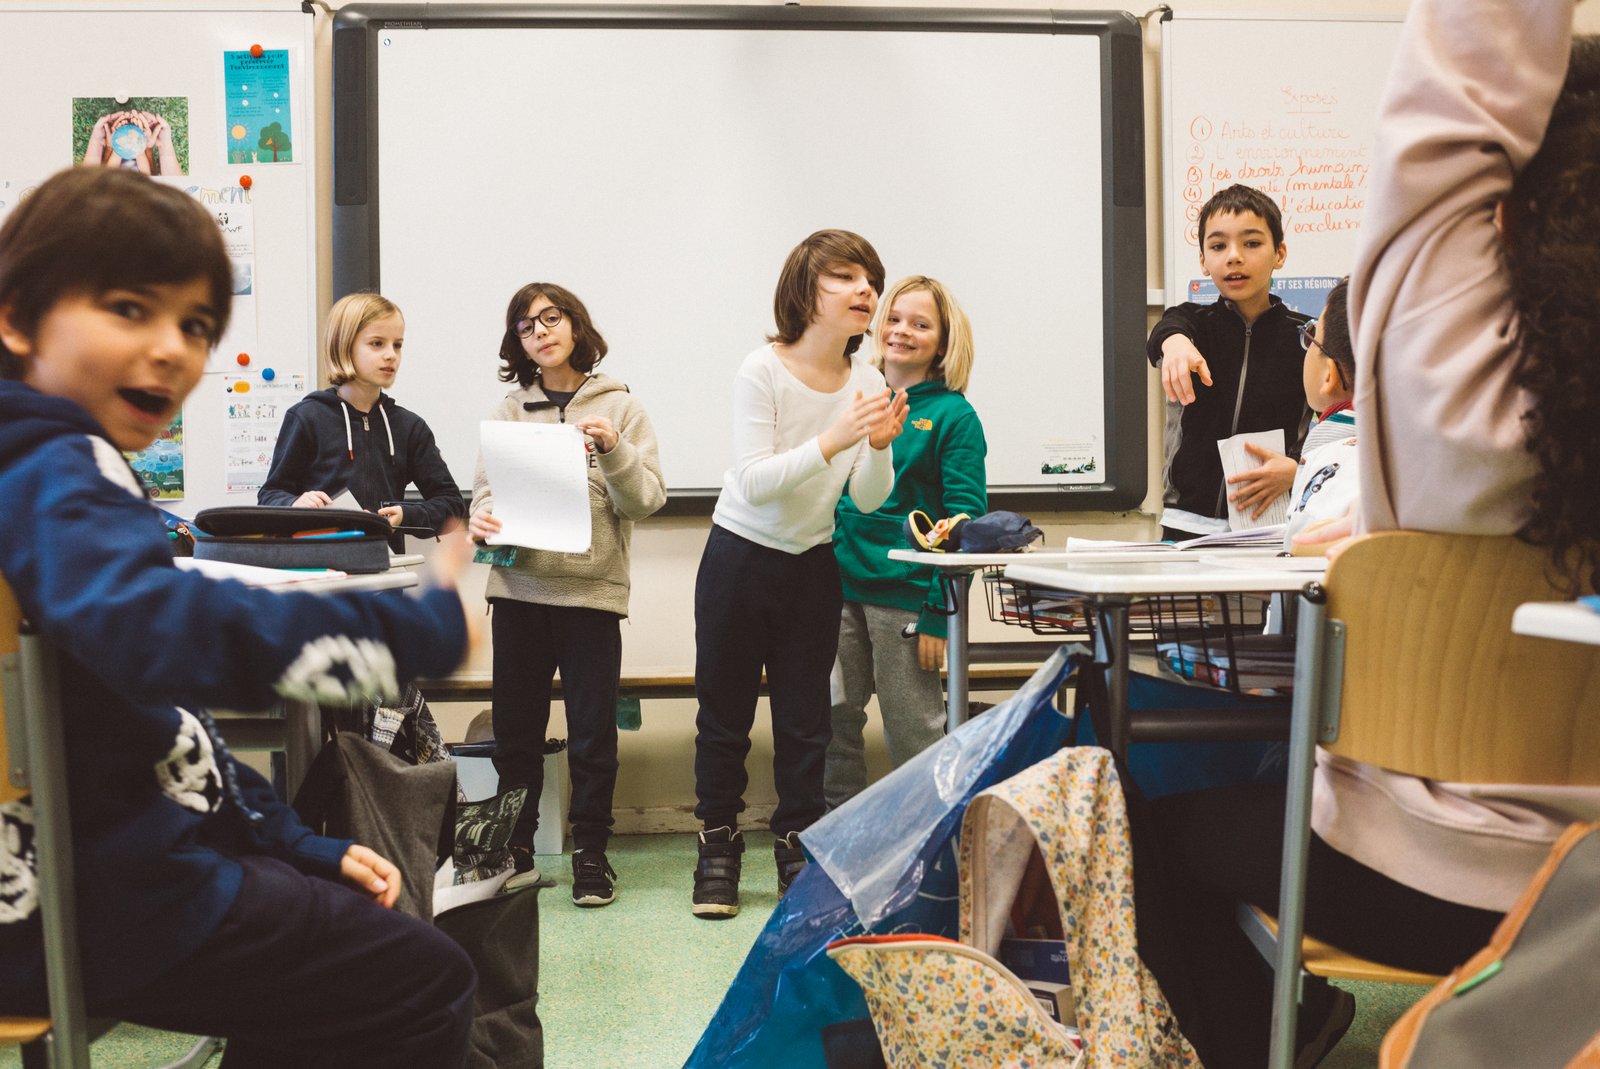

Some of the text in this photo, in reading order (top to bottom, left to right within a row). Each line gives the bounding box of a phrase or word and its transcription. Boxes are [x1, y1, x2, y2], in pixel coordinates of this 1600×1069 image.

[1221, 121, 1255, 139] Arts
[1261, 121, 1274, 139] et
[1280, 118, 1350, 139] culture
[1210, 162, 1232, 180] Les
[1238, 160, 1284, 177] droits
[1278, 279, 1287, 289] ET
[1288, 279, 1303, 289] SES
[1305, 277, 1338, 289] RÉGIONS
